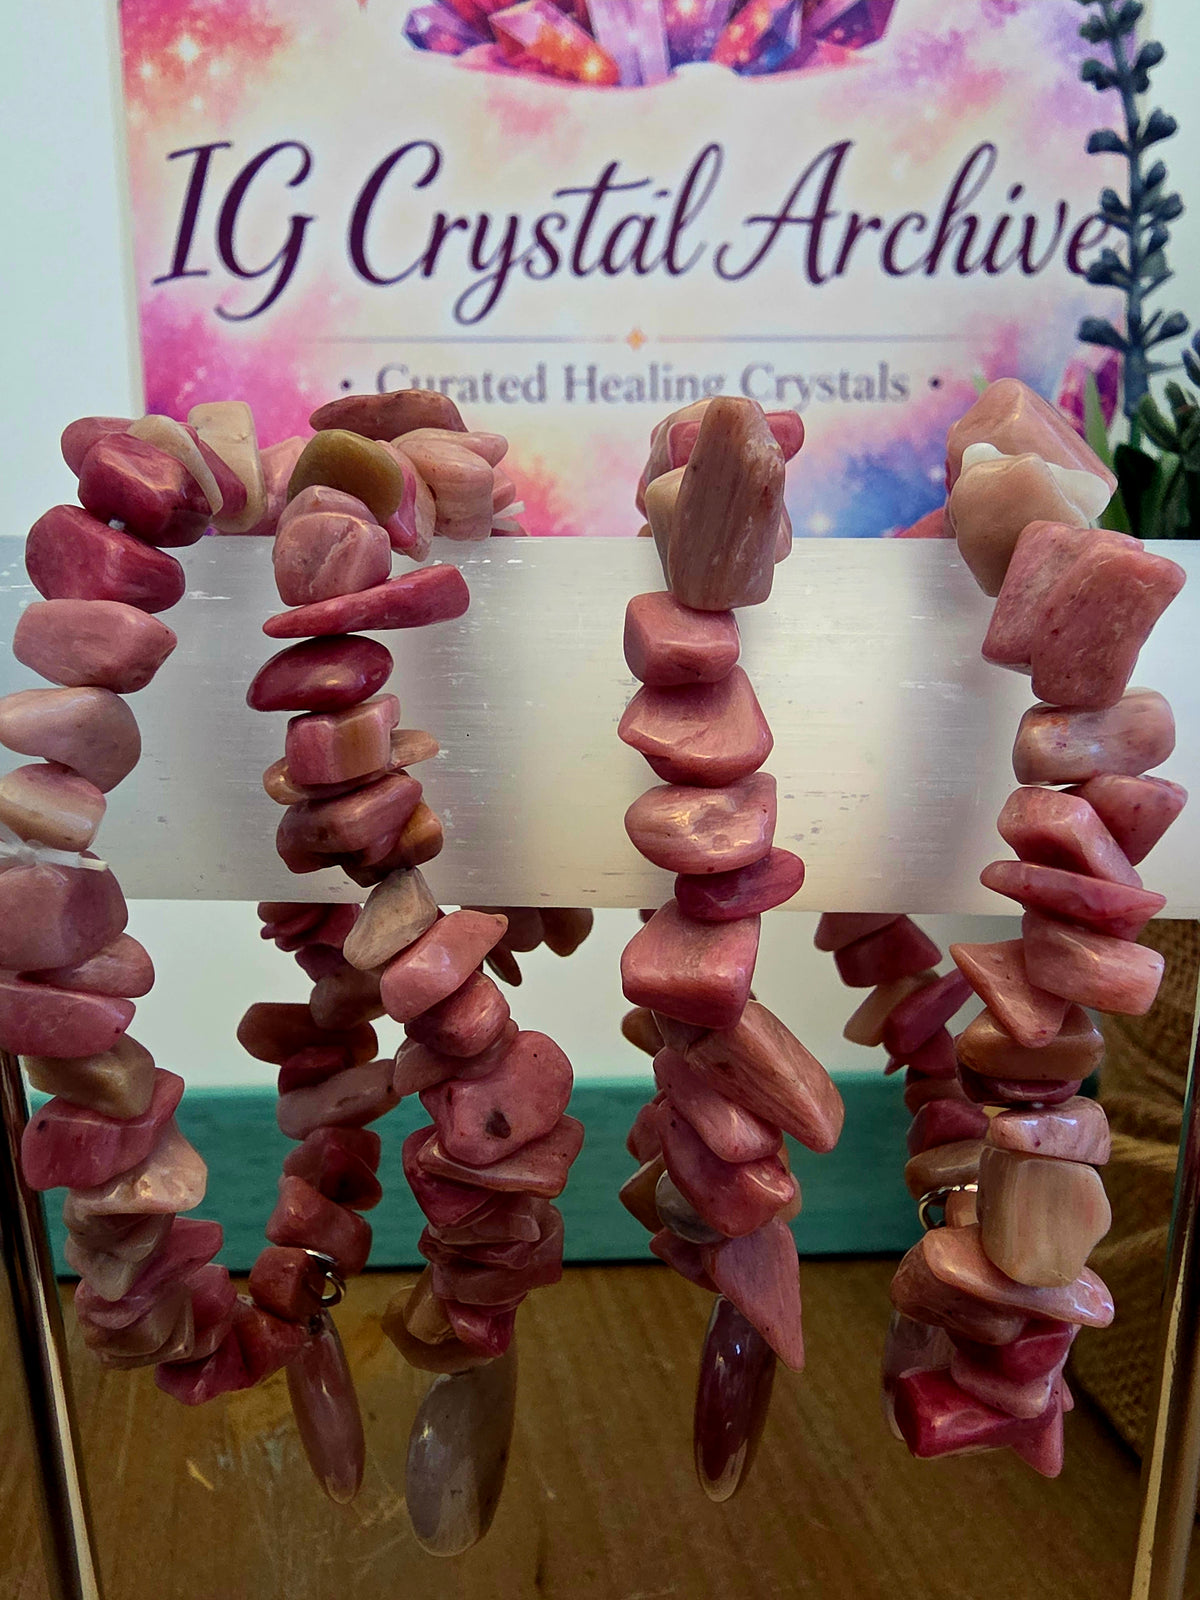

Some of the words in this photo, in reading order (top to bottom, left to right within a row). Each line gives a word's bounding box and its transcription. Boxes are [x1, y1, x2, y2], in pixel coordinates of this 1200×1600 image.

[152, 140, 317, 322] IG
[347, 140, 724, 325] Crystal
[714, 139, 1118, 286] Archive
[564, 361, 727, 402] Healing
[740, 361, 911, 412] Crystals
